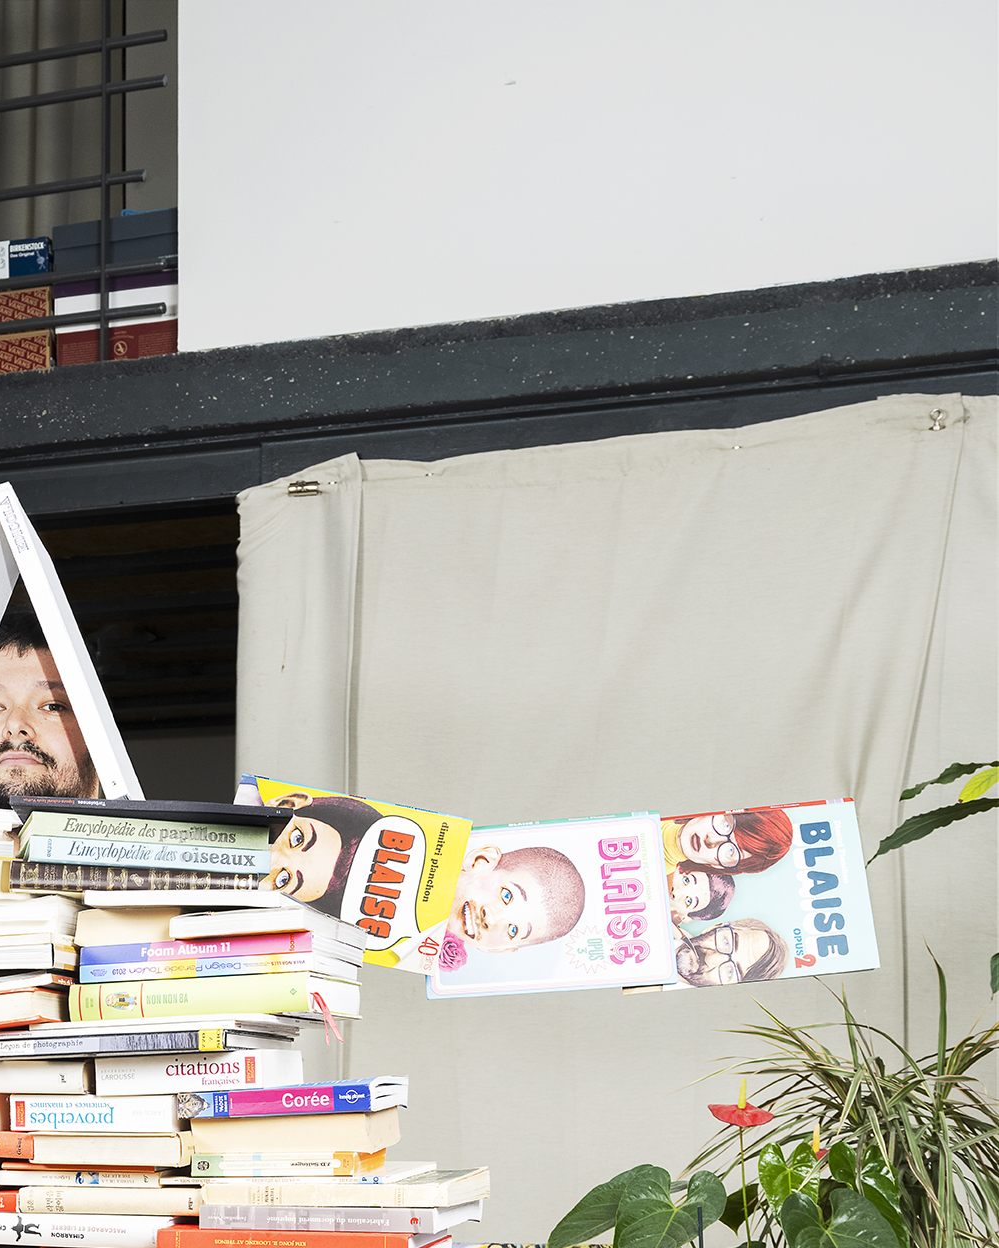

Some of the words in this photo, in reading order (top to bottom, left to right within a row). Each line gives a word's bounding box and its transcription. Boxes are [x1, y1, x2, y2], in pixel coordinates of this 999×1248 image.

[9, 241, 45, 253] BIRKENSTOCK
[21, 294, 39, 306] VANS
[0, 495, 30, 554] EDICOLA
[62, 816, 138, 838] Encyclopédie
[137, 824, 157, 838] des
[159, 823, 237, 845] papillons
[435, 821, 449, 856] dimitri
[68, 839, 152, 862] Encyclopédie
[154, 845, 177, 862] des
[181, 848, 257, 868] oiseaux
[355, 829, 416, 940] BLAISE
[422, 857, 439, 903] planchon
[799, 820, 850, 958] BLAISE
[598, 835, 651, 965] BLAISE
[140, 947, 176, 958] Foam
[177, 943, 219, 957] Album
[219, 941, 232, 955] 11
[417, 936, 440, 957] 40
[586, 937, 605, 962] OPUS
[792, 927, 805, 957] OPUS
[205, 962, 241, 975] Design
[794, 953, 817, 969] 2
[111, 968, 127, 979] 2019
[129, 965, 162, 978] Toulon
[164, 963, 202, 977] Parade
[32, 1039, 84, 1050] photographie
[165, 1056, 240, 1079] citations
[101, 1072, 136, 1081] LAROUSSE
[201, 1076, 240, 1087] françaises
[281, 1091, 331, 1109] Corée
[29, 1107, 115, 1129] proverbes
[267, 1213, 296, 1225] imprimé
[298, 1215, 334, 1225] document
[348, 1217, 390, 1226] Fabrication
[50, 1232, 85, 1240] CIMARRON
[86, 1226, 126, 1235] MASCARADE
